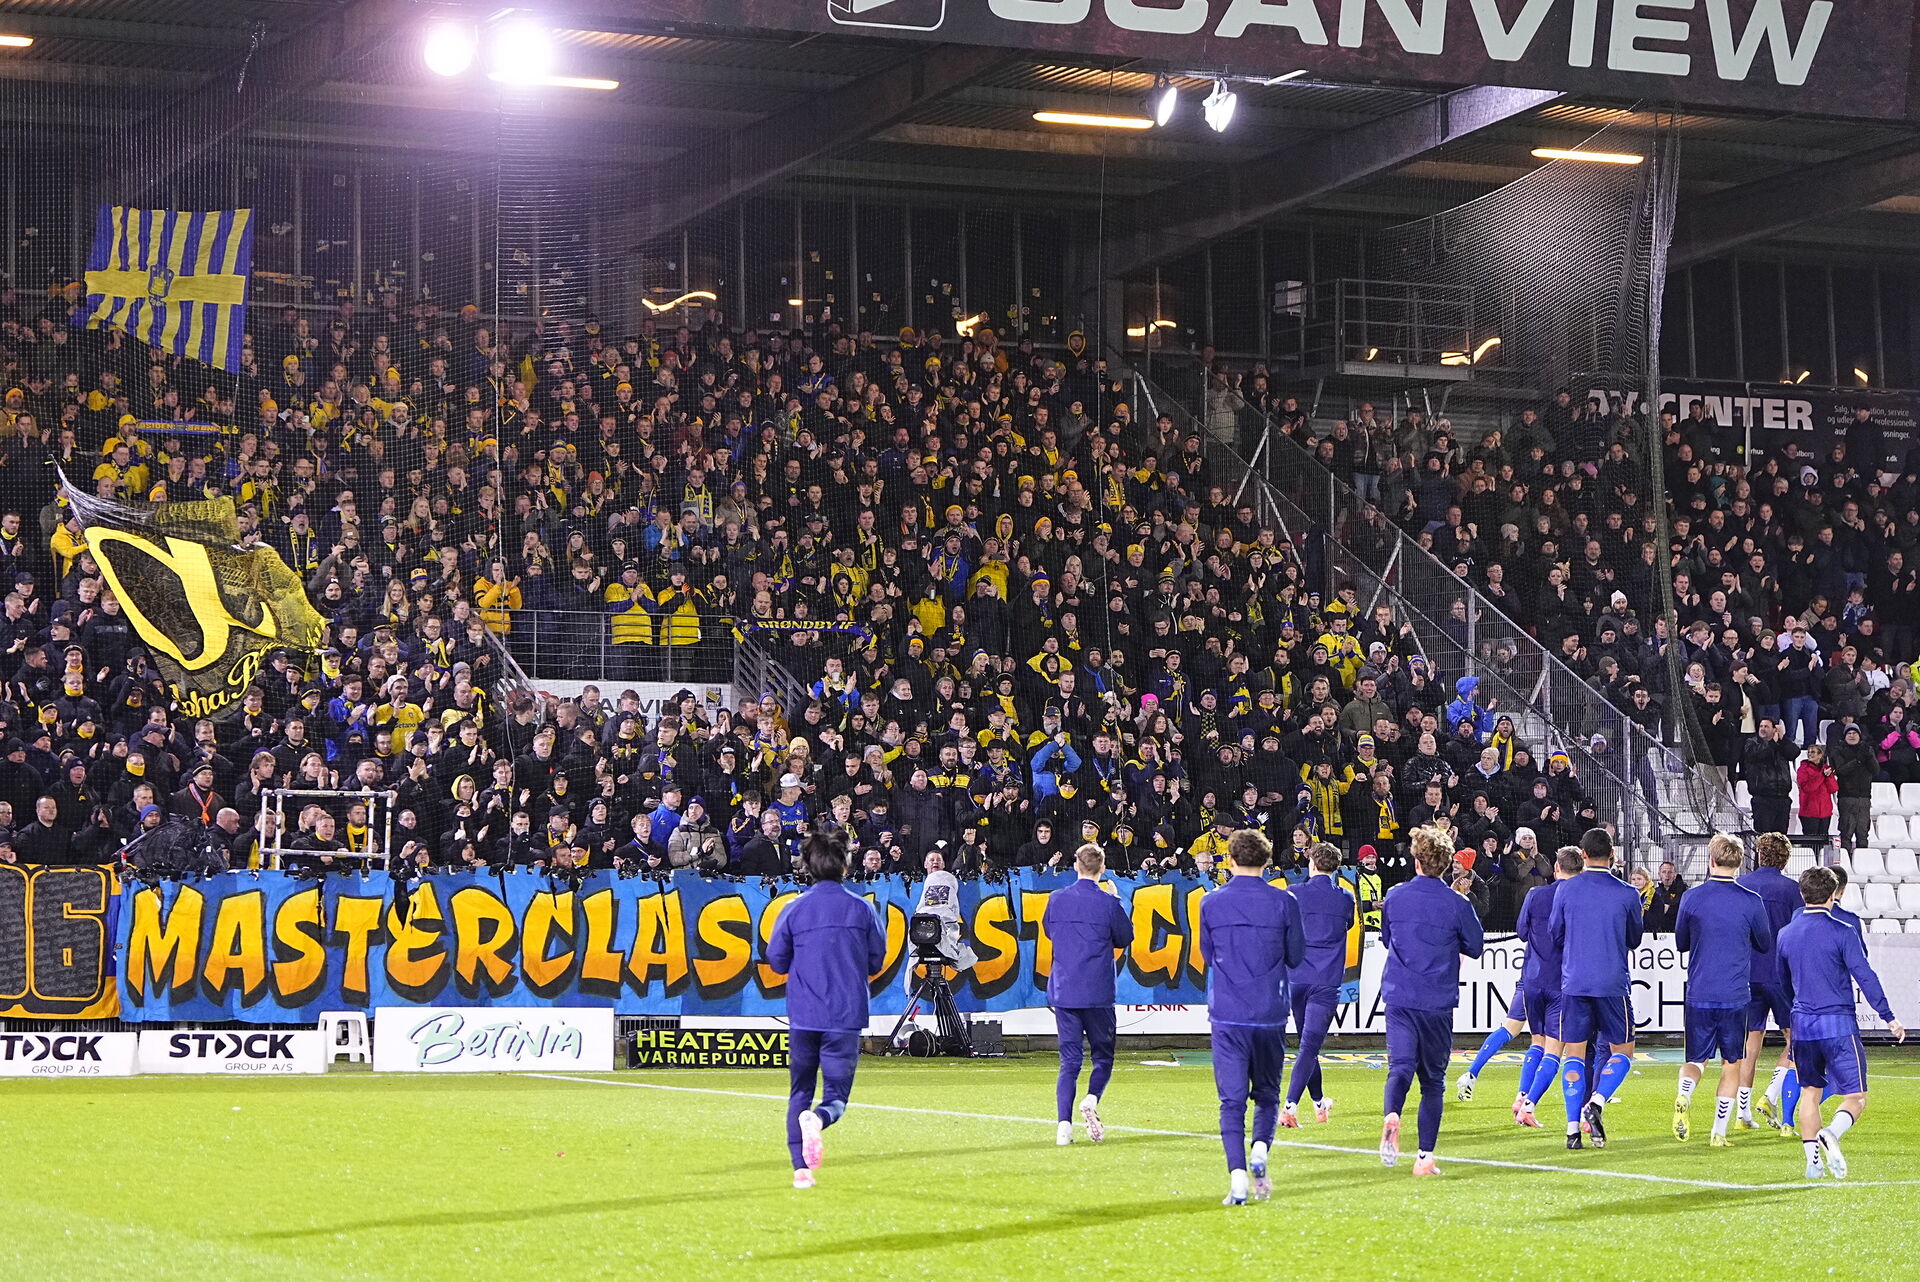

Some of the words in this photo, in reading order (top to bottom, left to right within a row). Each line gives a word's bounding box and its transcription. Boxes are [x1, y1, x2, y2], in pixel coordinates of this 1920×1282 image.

[838, 621, 857, 630] IF
[636, 1030, 790, 1051] HEATSAVE
[169, 1033, 294, 1059] STOCK
[32, 1065, 74, 1074] GROUP
[78, 1065, 100, 1075] A/S
[225, 1062, 267, 1071] GROUP
[272, 1062, 293, 1072] A/S
